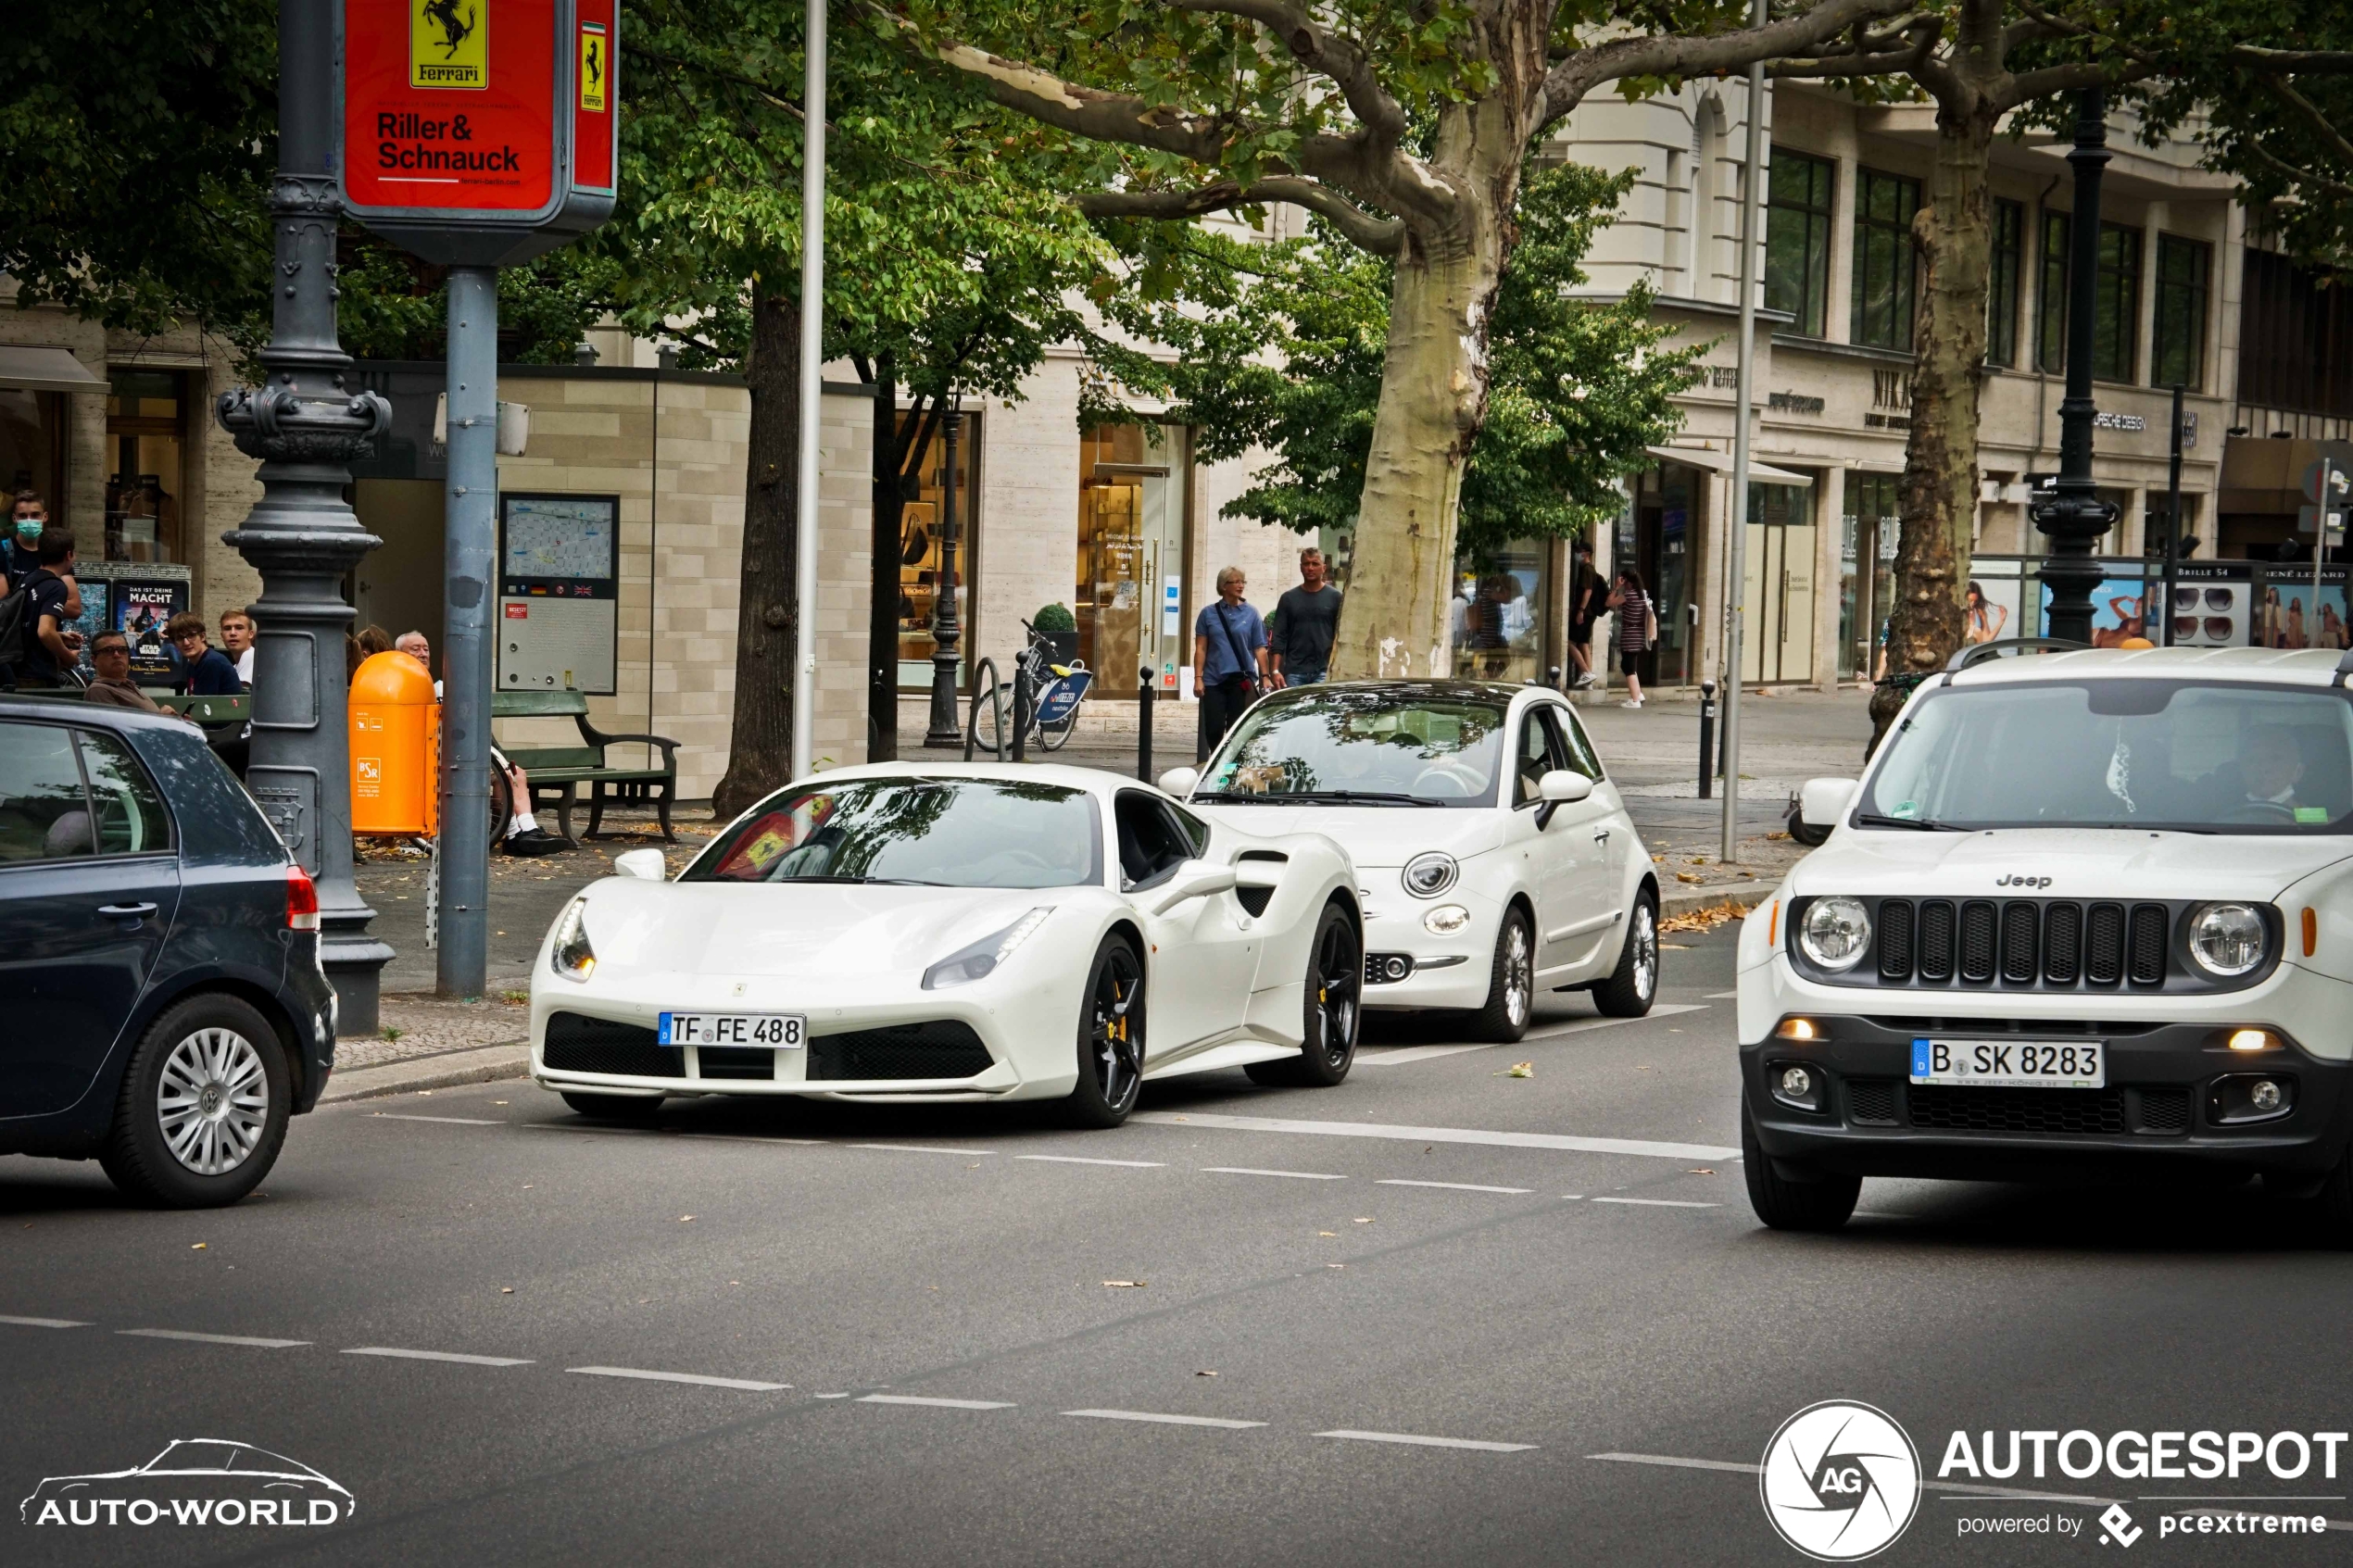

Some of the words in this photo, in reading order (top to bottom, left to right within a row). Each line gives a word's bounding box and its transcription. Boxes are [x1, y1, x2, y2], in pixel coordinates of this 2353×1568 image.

[419, 65, 479, 82] Ferrari
[584, 94, 602, 107] Ferrari
[378, 142, 521, 171] Schnauck
[461, 177, 521, 186] ferrari-berlin.com
[2122, 414, 2146, 431] DESIGN
[2217, 568, 2228, 576] 54
[130, 594, 172, 603] MACHT
[359, 762, 378, 778] BSR
[1996, 873, 2053, 889] Jeep
[661, 1032, 667, 1040] D
[673, 1016, 701, 1041] TF
[716, 1018, 748, 1043] FE
[753, 1019, 799, 1044] 488
[1918, 1061, 1925, 1071] D
[1932, 1044, 1951, 1073] B
[1973, 1045, 2012, 1074] SK
[2020, 1046, 2097, 1076] 8283
